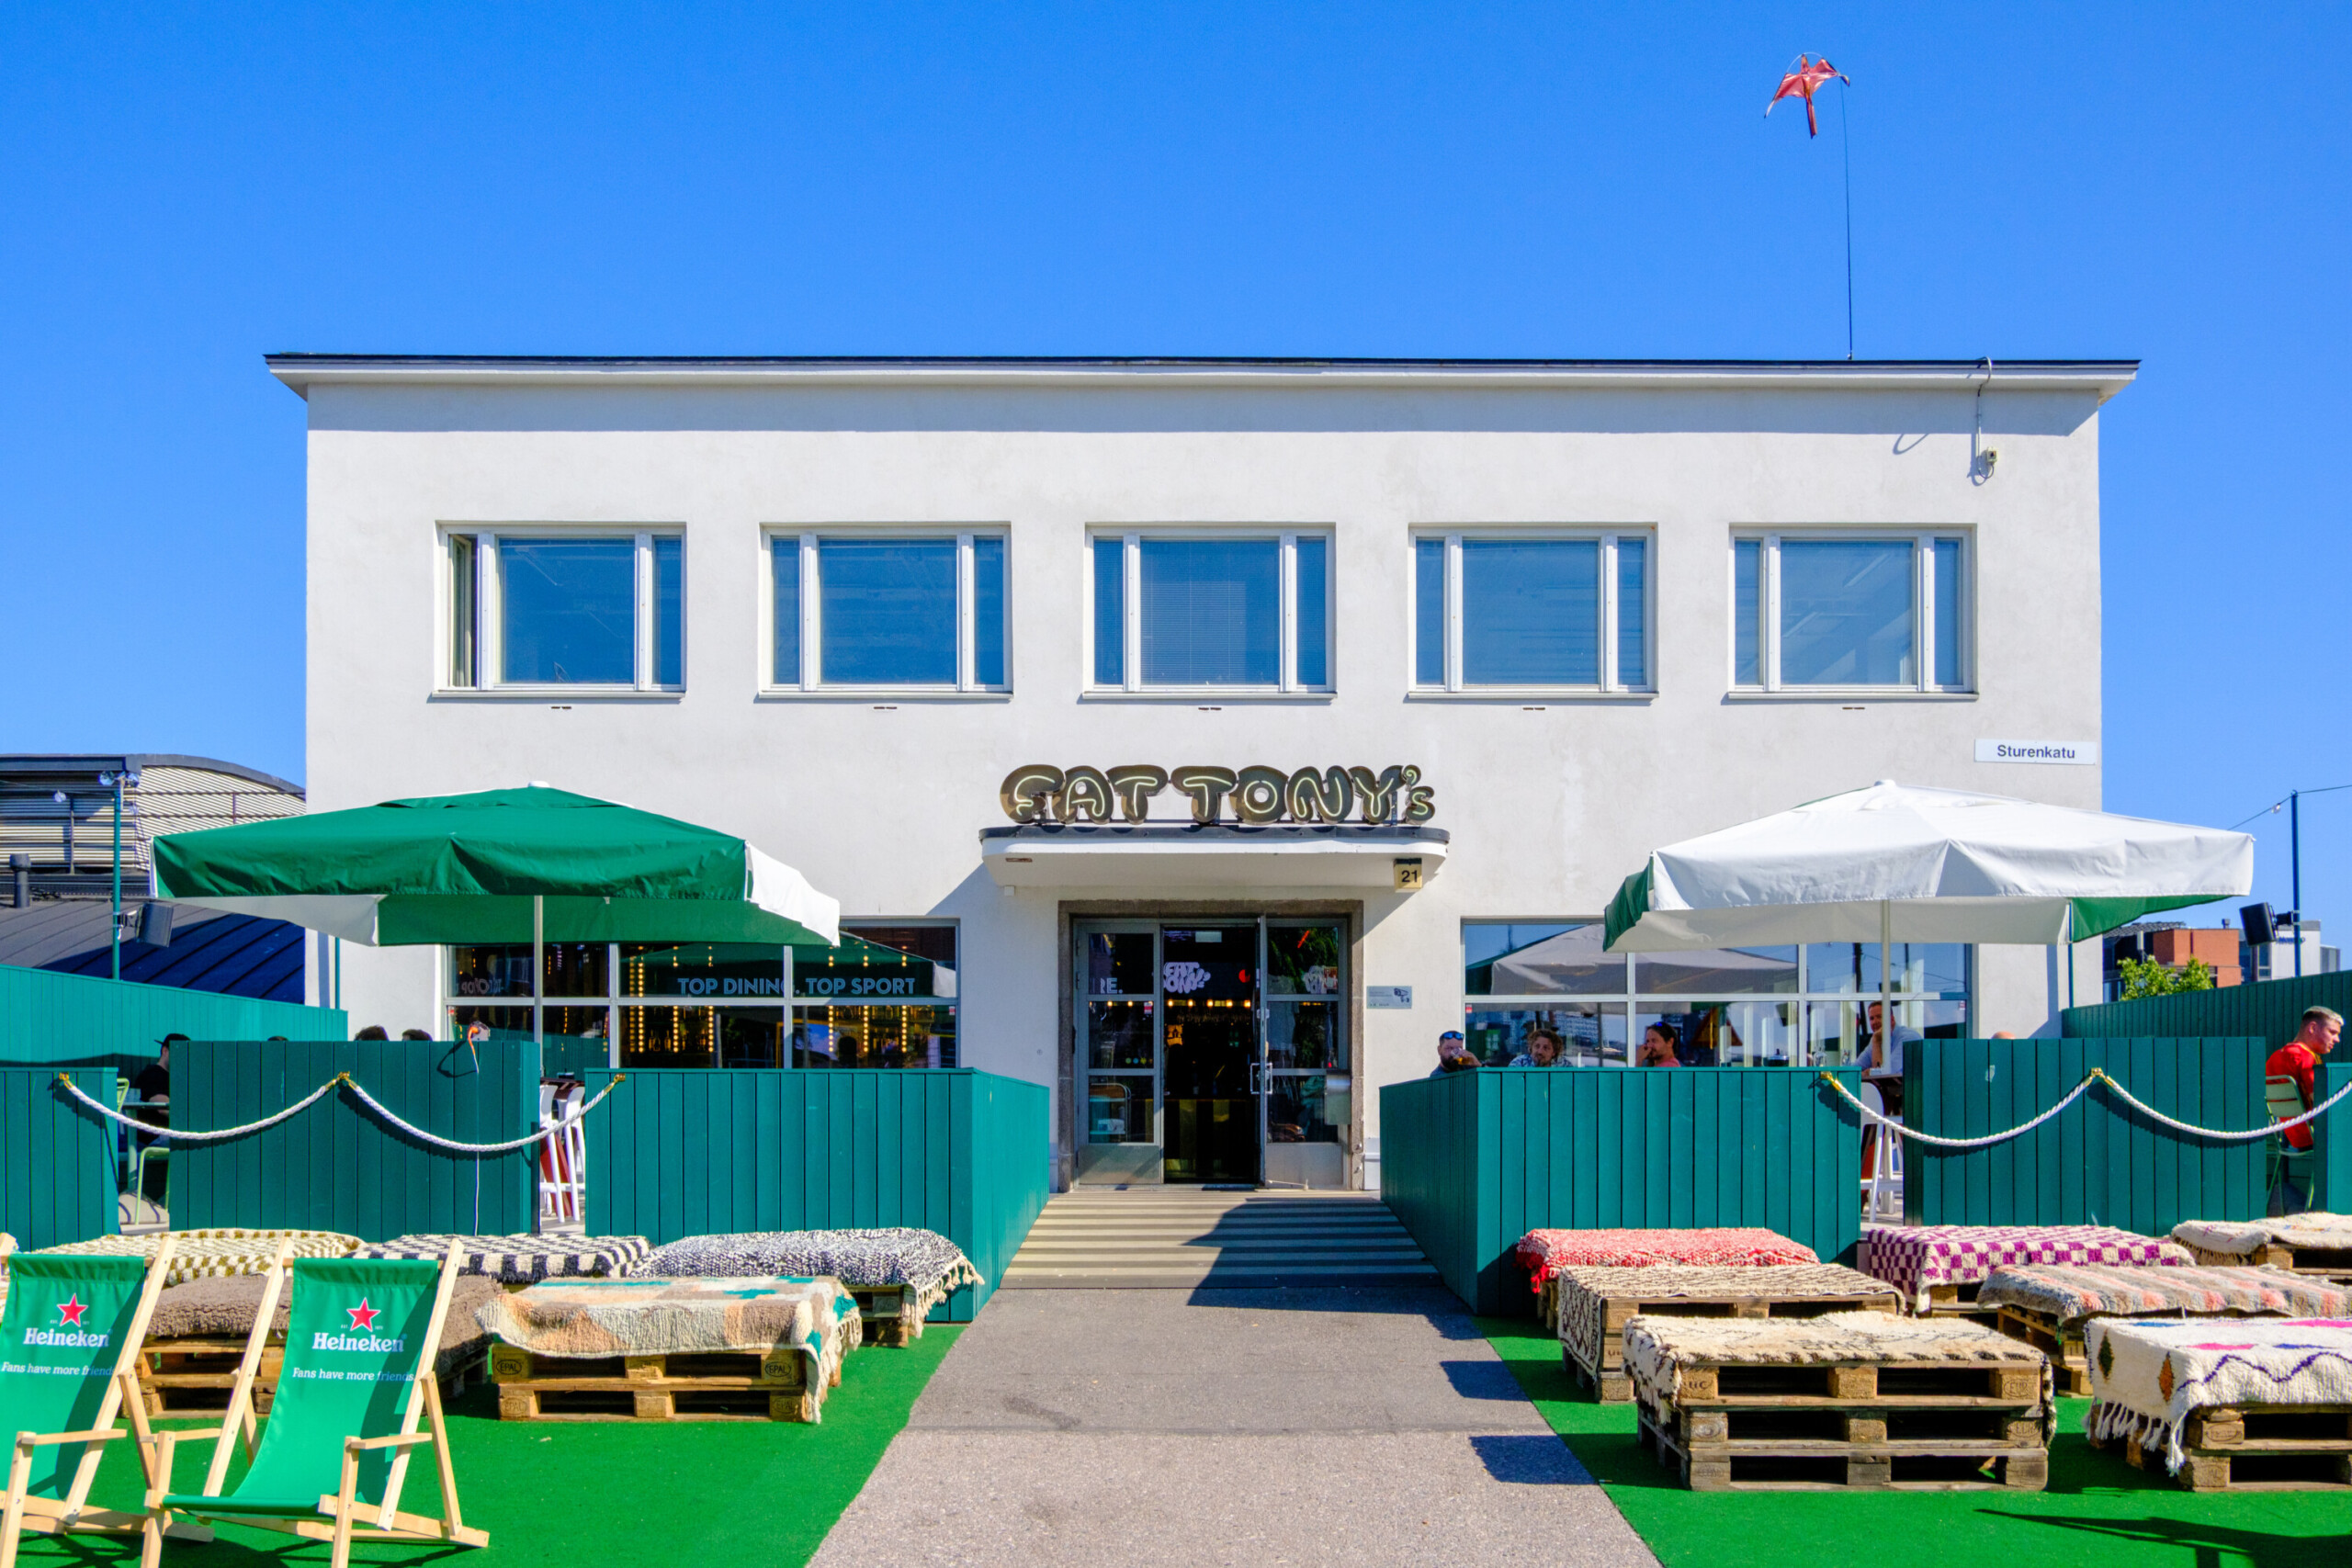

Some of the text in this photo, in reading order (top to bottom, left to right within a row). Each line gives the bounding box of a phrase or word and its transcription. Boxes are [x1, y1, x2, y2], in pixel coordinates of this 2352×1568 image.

[1996, 744, 2076, 760] Sturenkatu
[1000, 764, 1169, 825] FAT
[1401, 870, 1418, 883] 21
[677, 977, 718, 995] TOP
[805, 977, 846, 995] TOP
[851, 977, 916, 995] SPORT
[23, 1327, 109, 1348] Heineken
[312, 1332, 404, 1352] Heineken
[1, 1361, 26, 1373] Fans
[28, 1363, 51, 1374] have
[52, 1366, 80, 1375] more
[292, 1367, 317, 1379] Fans
[318, 1369, 345, 1380] have
[346, 1371, 375, 1381] more
[500, 1362, 518, 1372] EPAL
